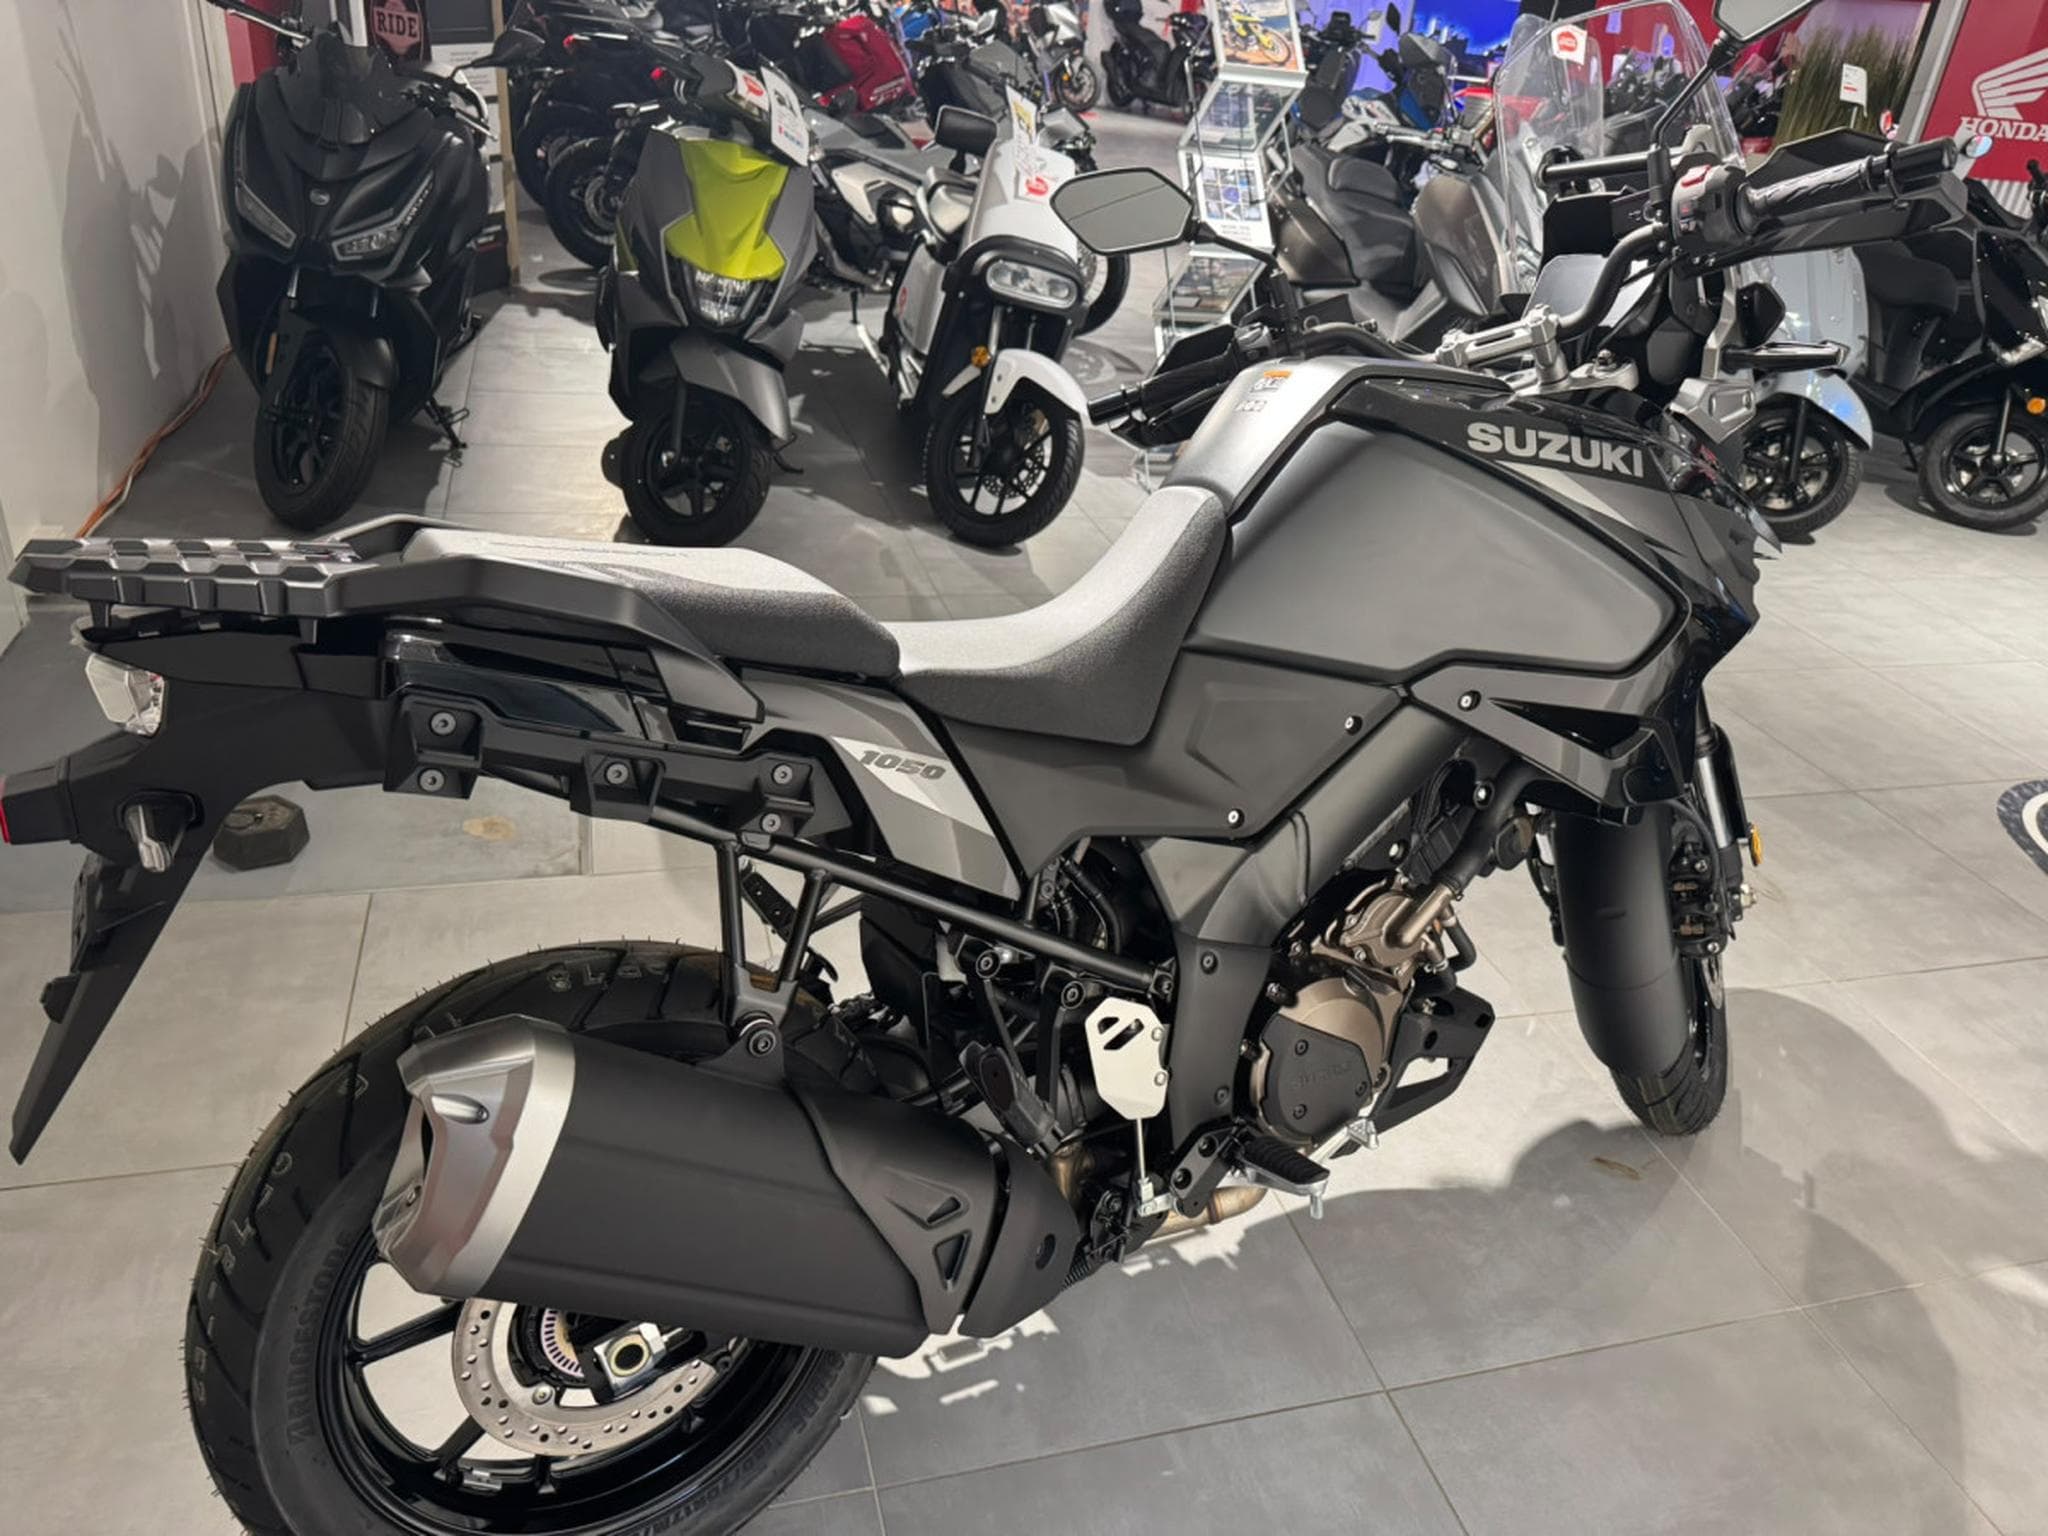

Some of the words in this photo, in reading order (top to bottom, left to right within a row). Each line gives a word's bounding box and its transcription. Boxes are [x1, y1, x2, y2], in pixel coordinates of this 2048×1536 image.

[376, 10, 417, 38] RIDE
[1959, 116, 2048, 142] HONDA
[1467, 422, 1644, 478] SUZUKI
[860, 750, 946, 780] 1050
